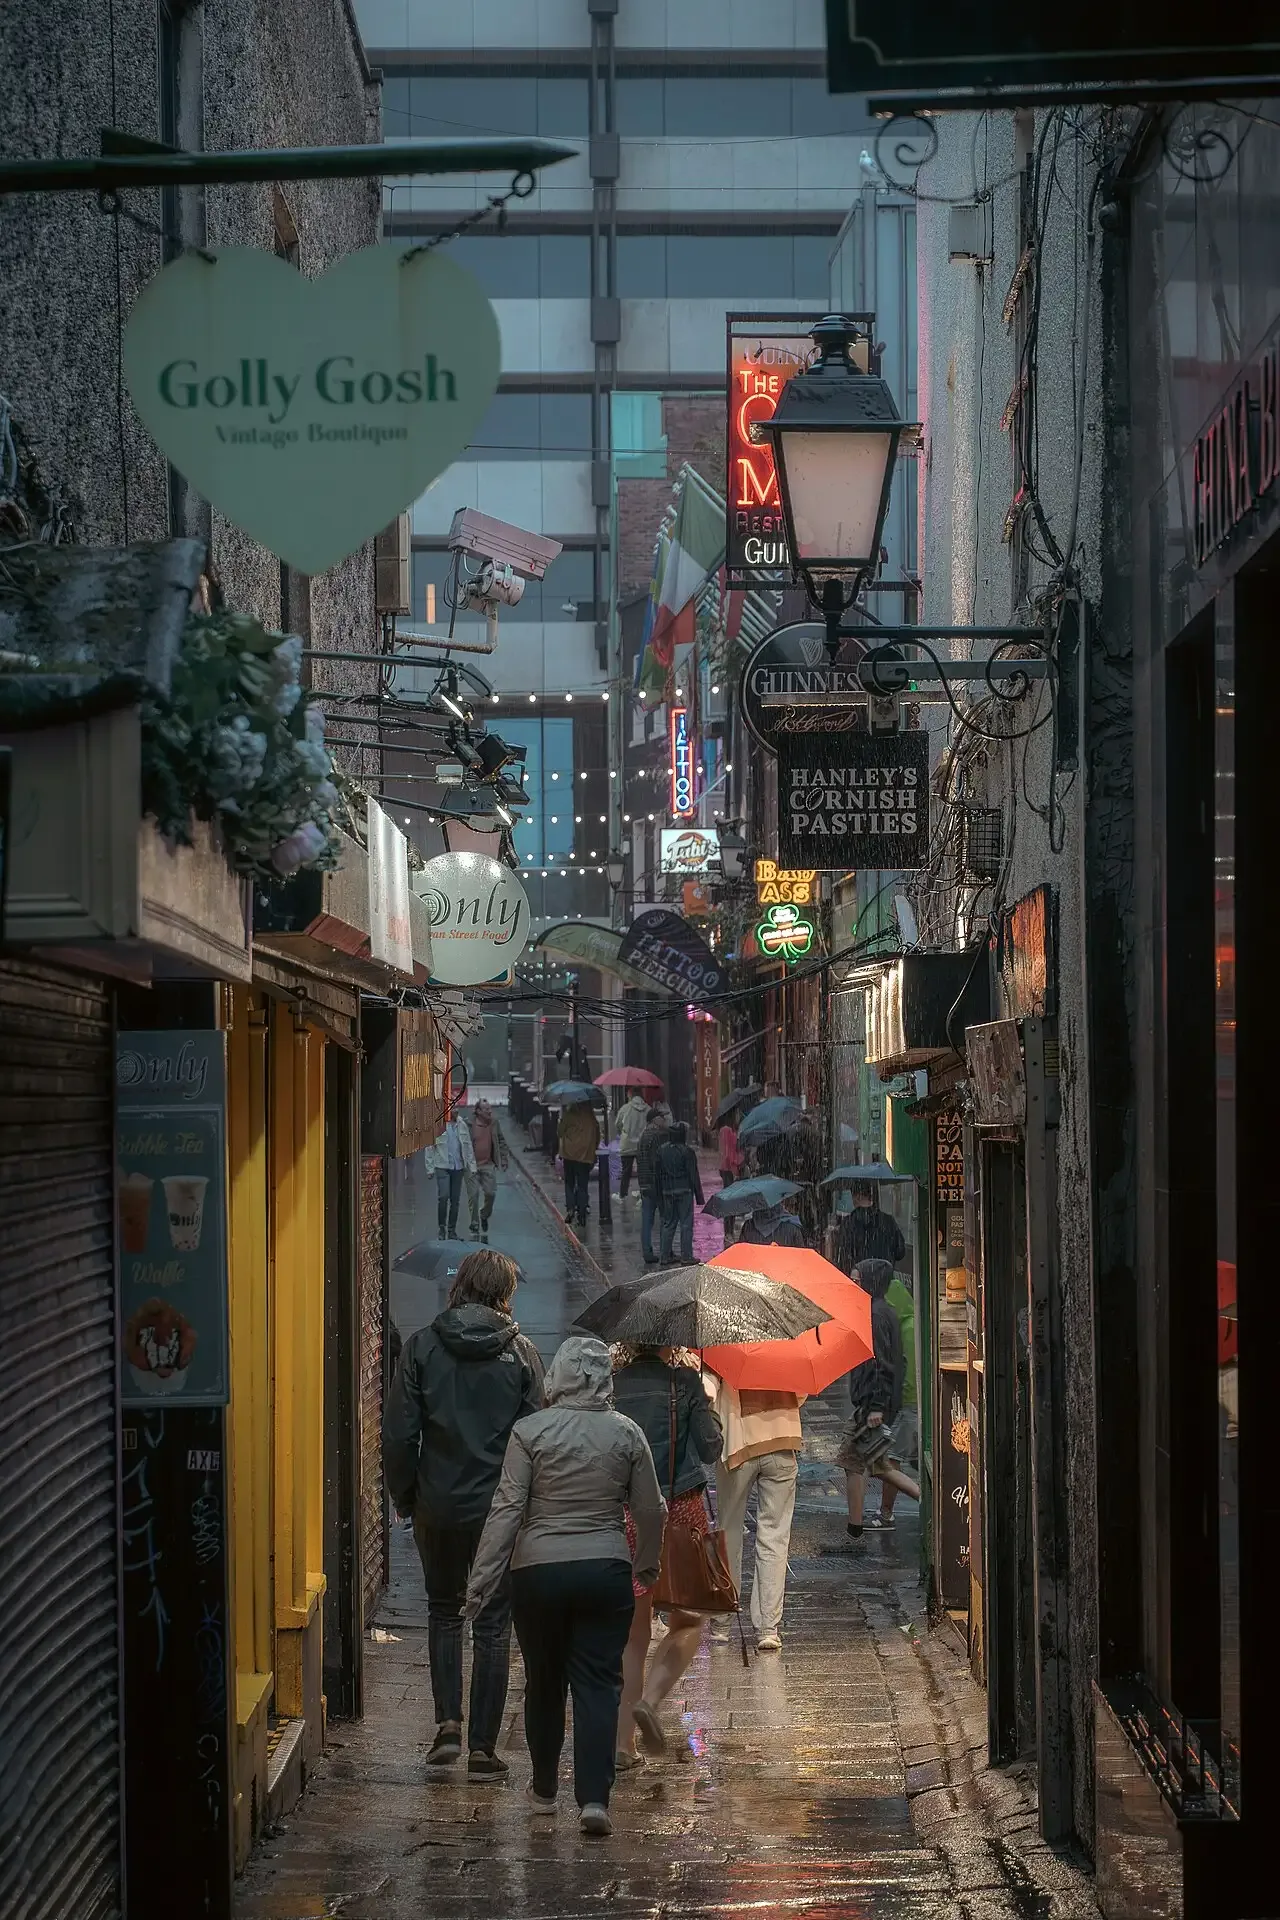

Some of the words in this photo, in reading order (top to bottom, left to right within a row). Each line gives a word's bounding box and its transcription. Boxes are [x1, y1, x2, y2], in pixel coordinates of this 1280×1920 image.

[157, 358, 301, 424] Golly
[315, 352, 459, 405] Gosh
[740, 370, 779, 393] THE
[736, 511, 782, 532] REST
[750, 668, 864, 697] GUINNES
[789, 787, 917, 811] CORNISH
[790, 812, 918, 836] PASTIES
[760, 882, 810, 903] ASS
[448, 929, 479, 940] Street
[481, 929, 509, 940] Food
[635, 930, 720, 989] TATTOO
[115, 1040, 209, 1101] Only
[704, 1086, 713, 1127] CITY
[174, 1131, 204, 1154] Tea
[131, 1259, 187, 1288] Waffle
